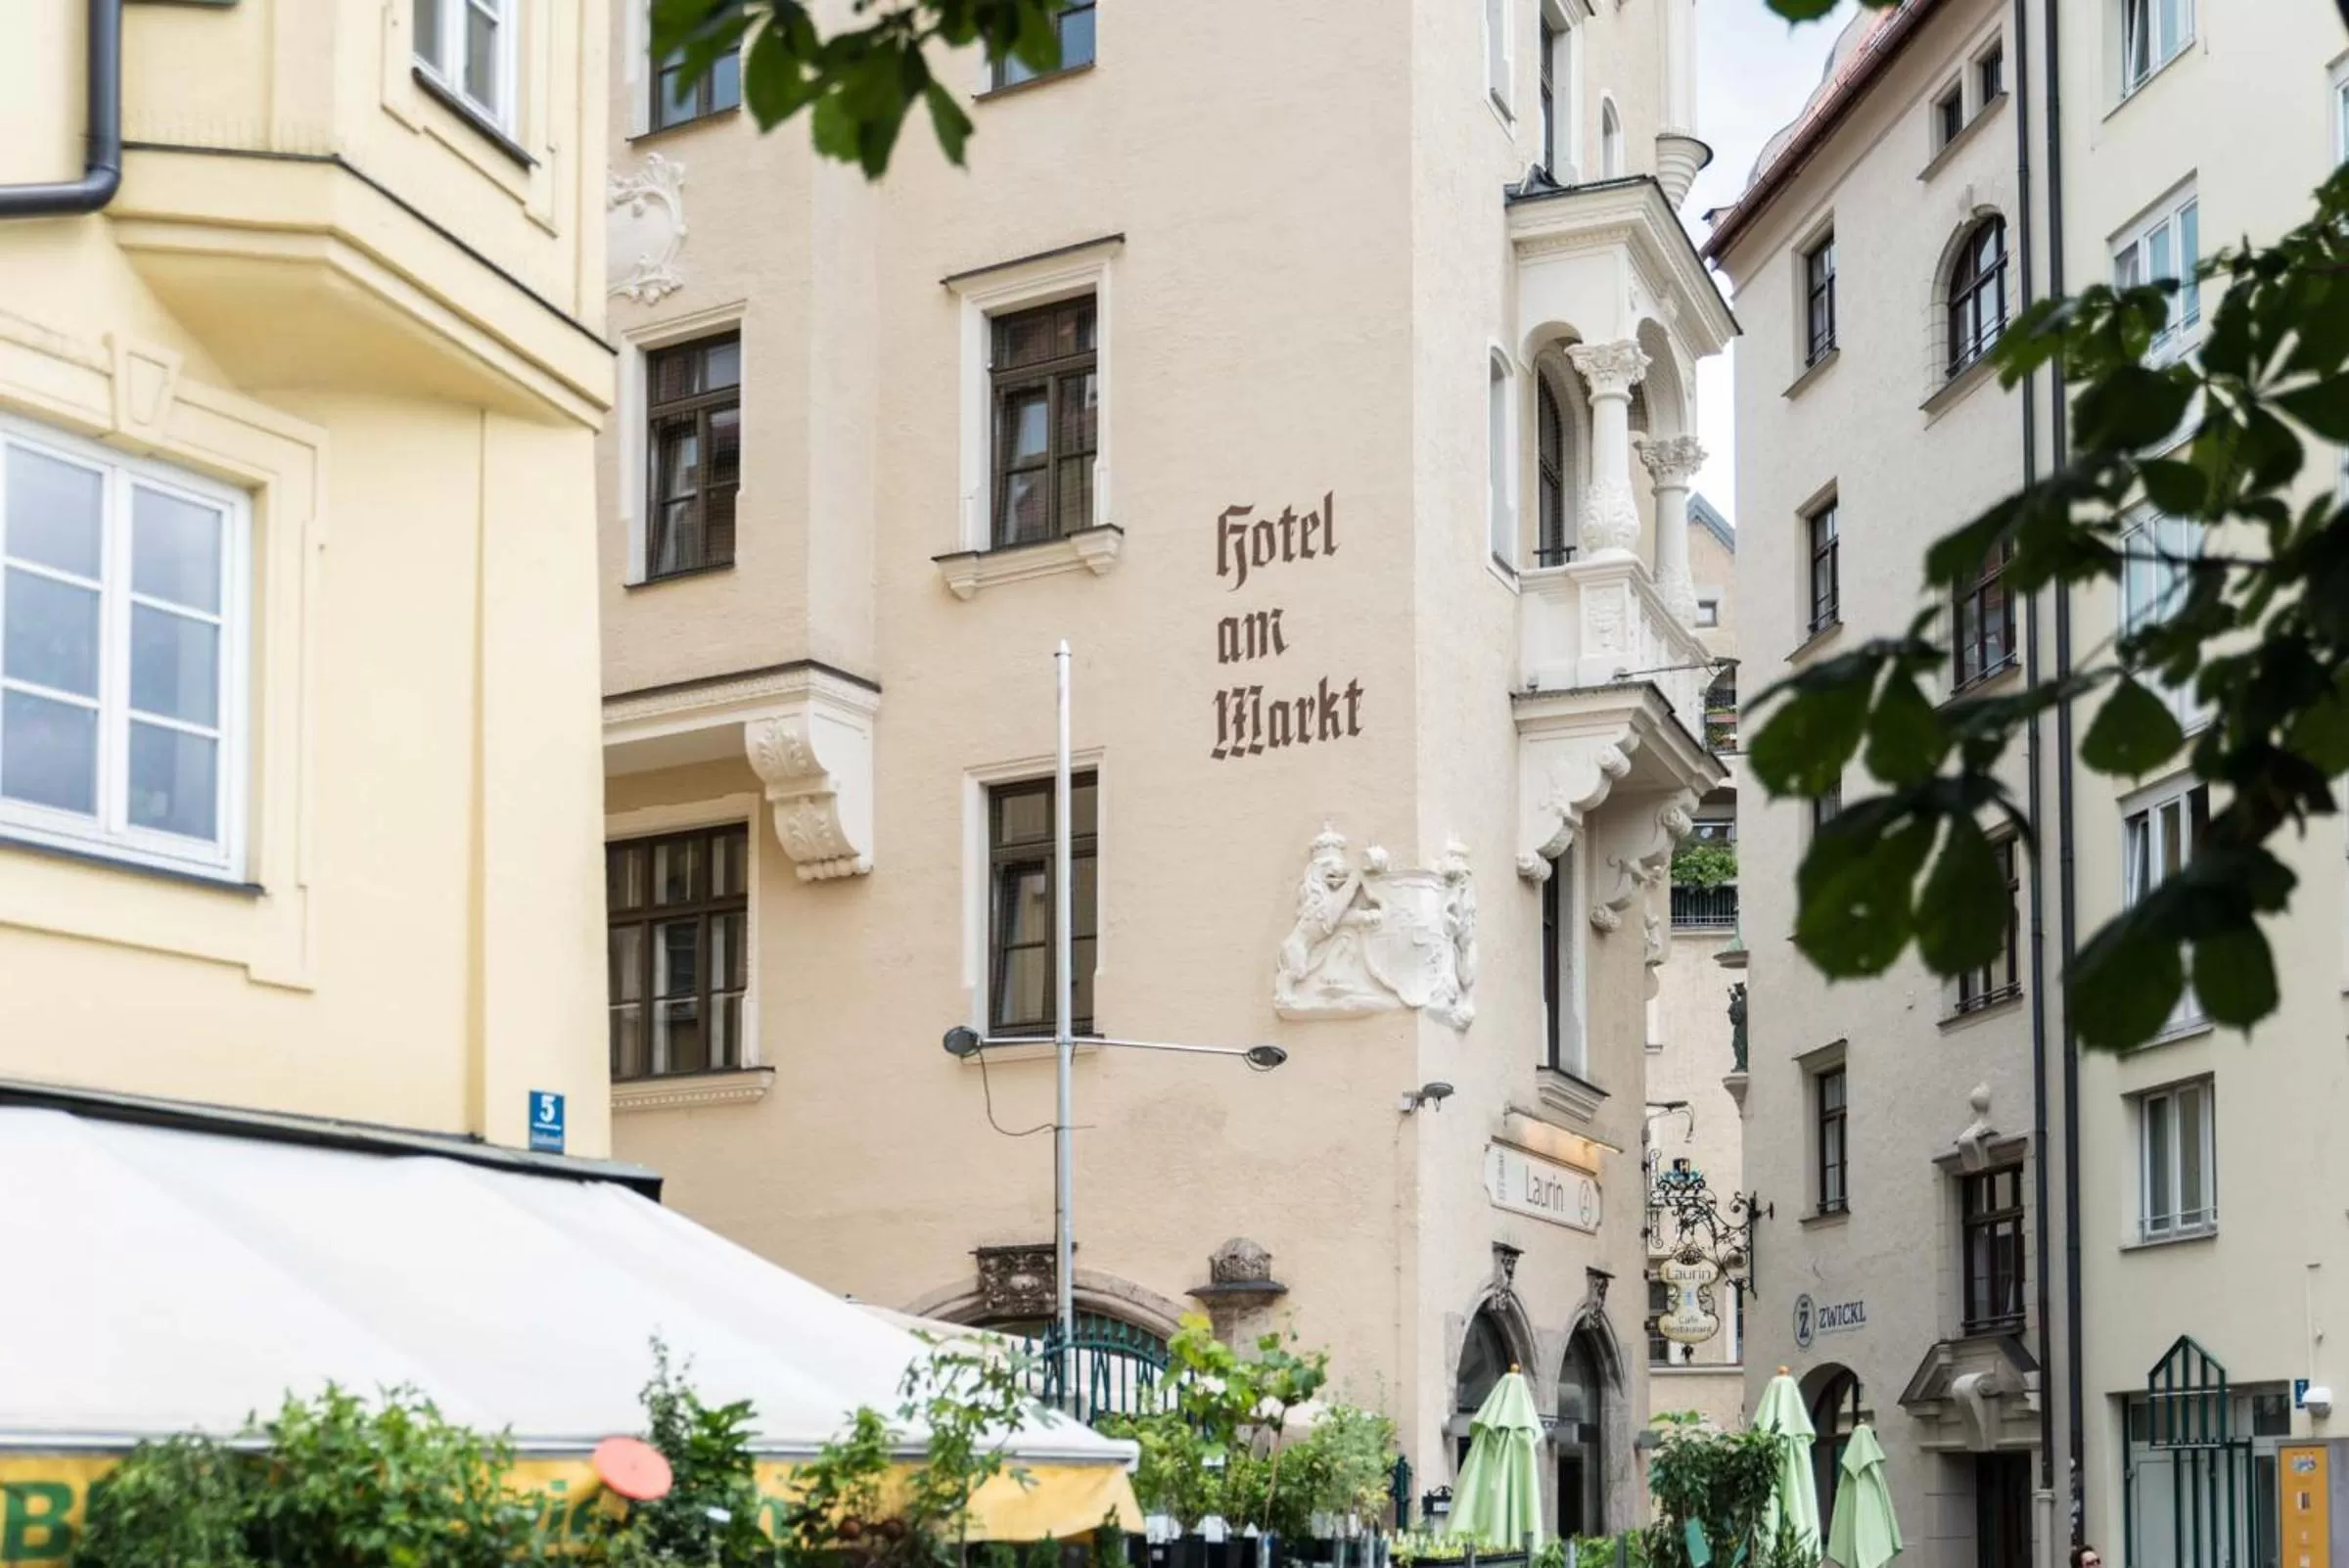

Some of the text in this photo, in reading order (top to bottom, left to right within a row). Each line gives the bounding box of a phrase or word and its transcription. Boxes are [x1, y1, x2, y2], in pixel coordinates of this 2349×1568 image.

[1216, 489, 1341, 593] Hotel
[1217, 607, 1290, 665] am
[1210, 673, 1365, 761] Markt
[539, 1093, 556, 1124] 5
[1525, 1164, 1565, 1213] Laurin
[1666, 1266, 1712, 1280] Laurin
[1819, 1300, 1866, 1329] ZWICKL
